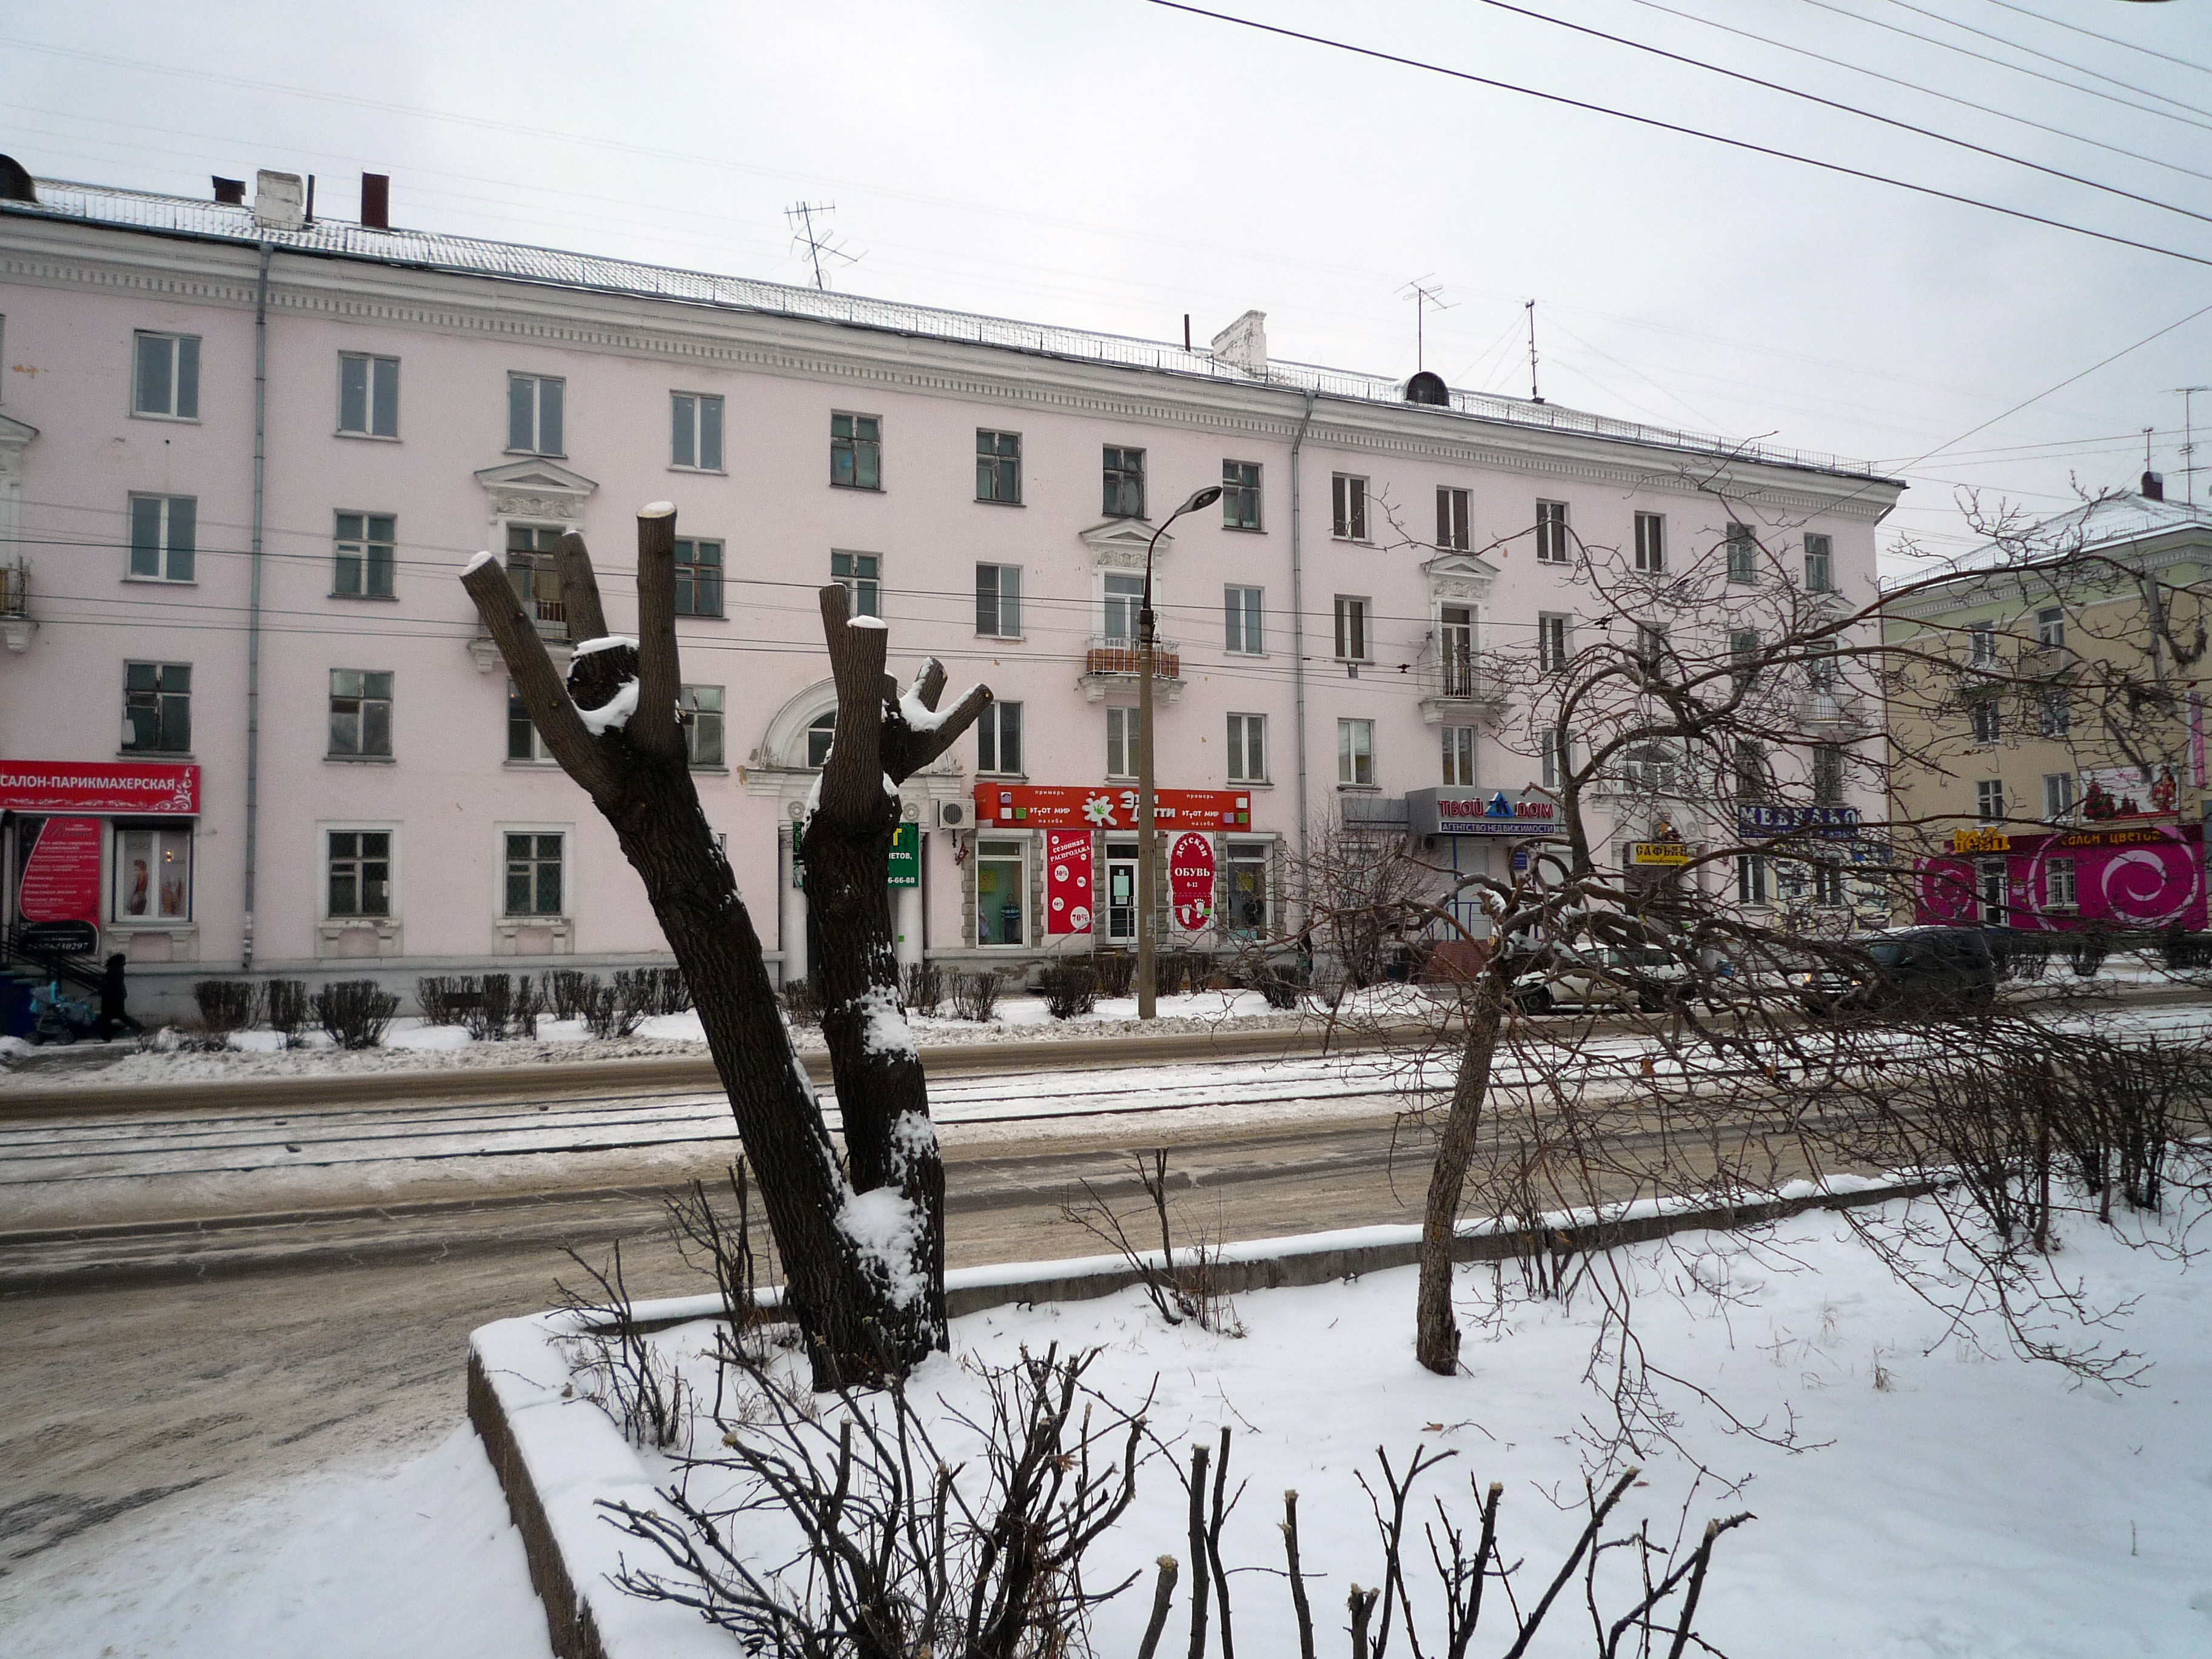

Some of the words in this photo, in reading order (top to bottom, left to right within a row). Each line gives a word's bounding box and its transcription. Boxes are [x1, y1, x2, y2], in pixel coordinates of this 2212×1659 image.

[0, 775, 175, 790] САЛОН-ПАРИКМАХЕРСКАЯ
[1439, 797, 1484, 817] ТВОЙ
[1516, 801, 1553, 818] ДОМ
[1443, 823, 1486, 832] АГЕНТСТВО
[1487, 823, 1553, 833] НЕДВИЖИМОСТИ
[1050, 845, 1091, 862] РАСПРОДАЖА
[1175, 868, 1210, 877] ОБУВЬ
